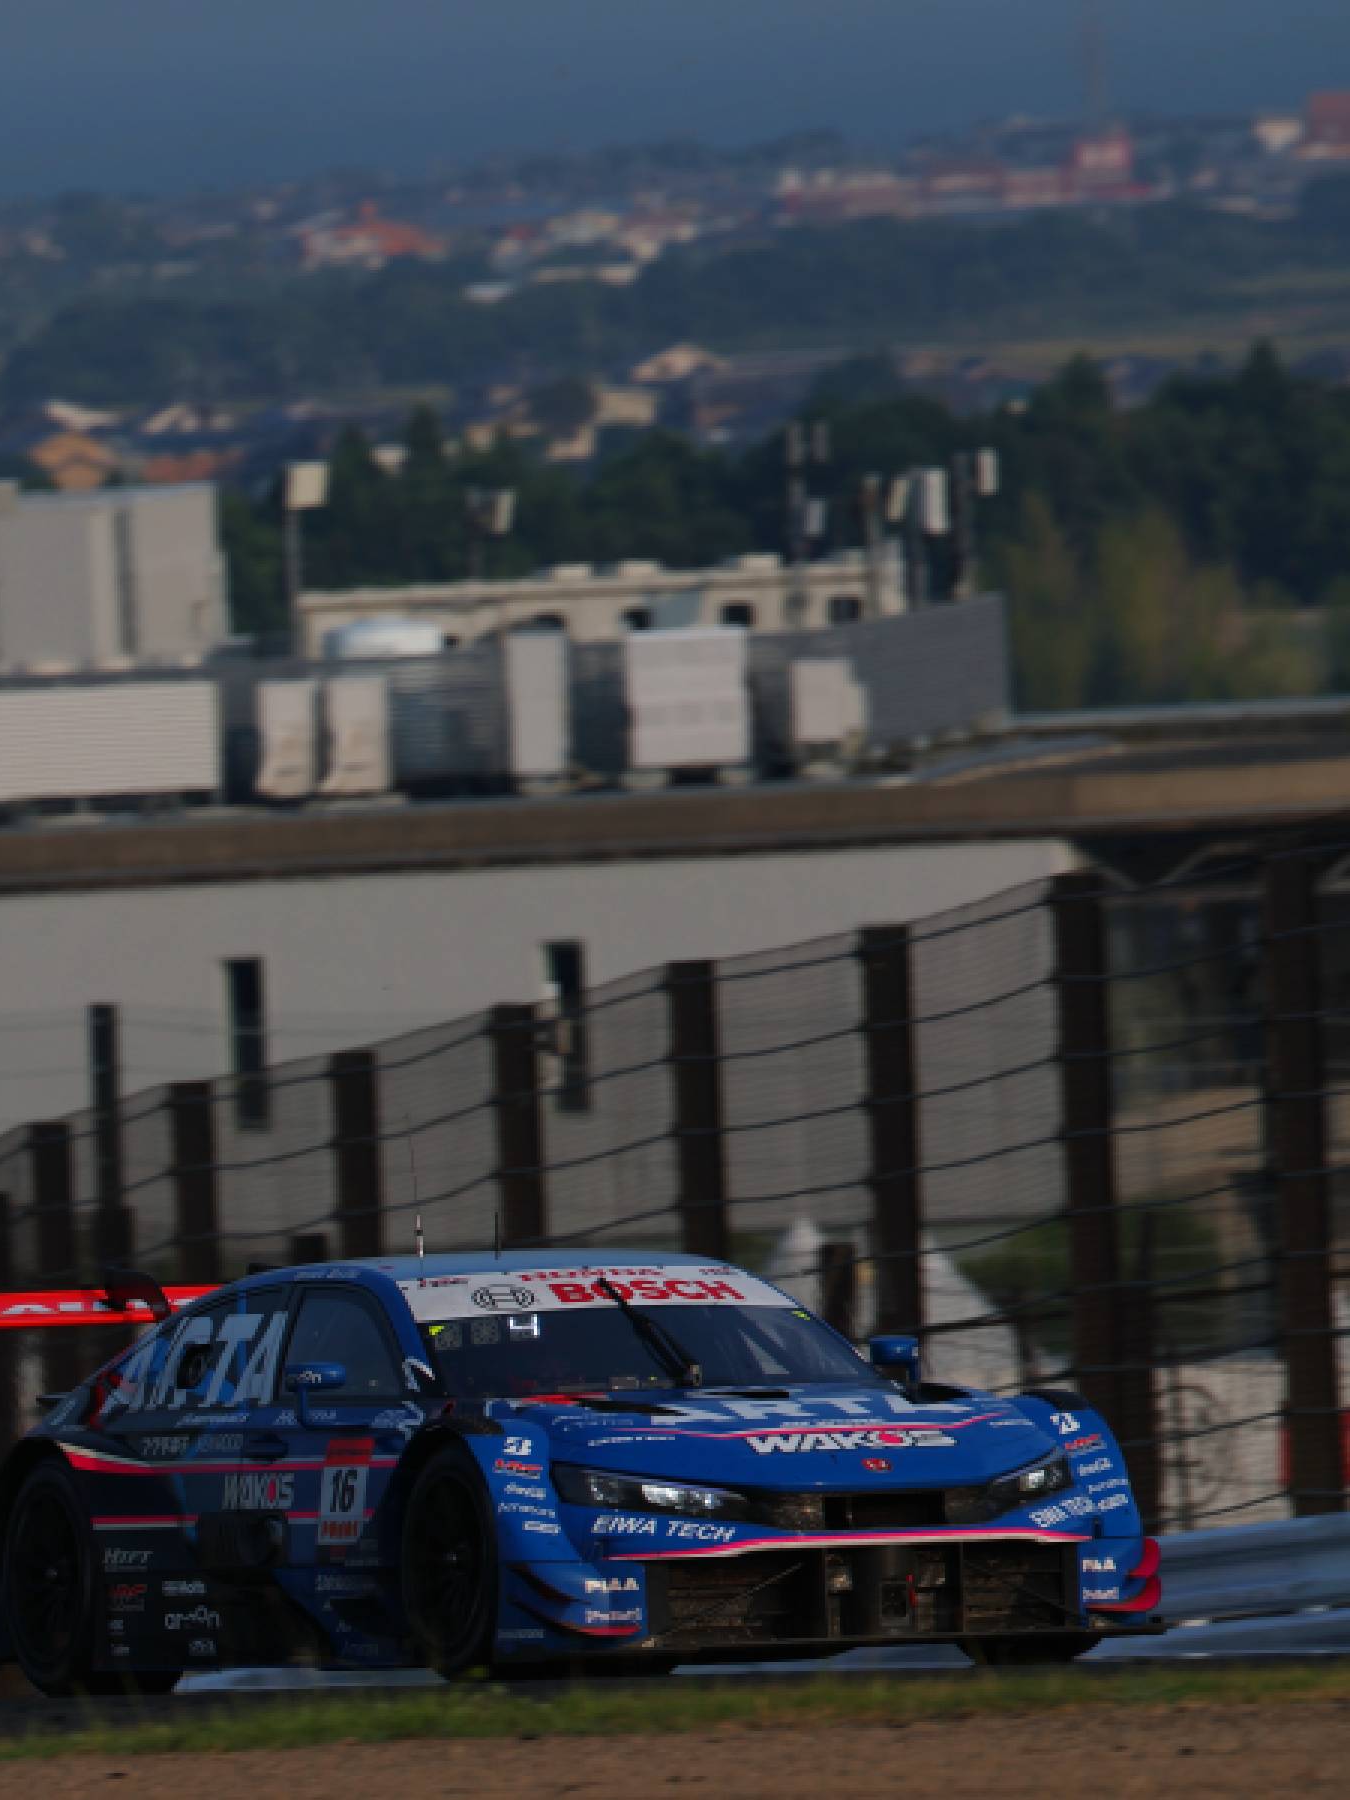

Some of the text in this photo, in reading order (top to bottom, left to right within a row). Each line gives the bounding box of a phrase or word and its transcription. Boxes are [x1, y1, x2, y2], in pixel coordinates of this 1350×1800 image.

[548, 1278, 744, 1303] BOSCH
[329, 1469, 358, 1513] 16
[666, 1520, 735, 1542] TECH
